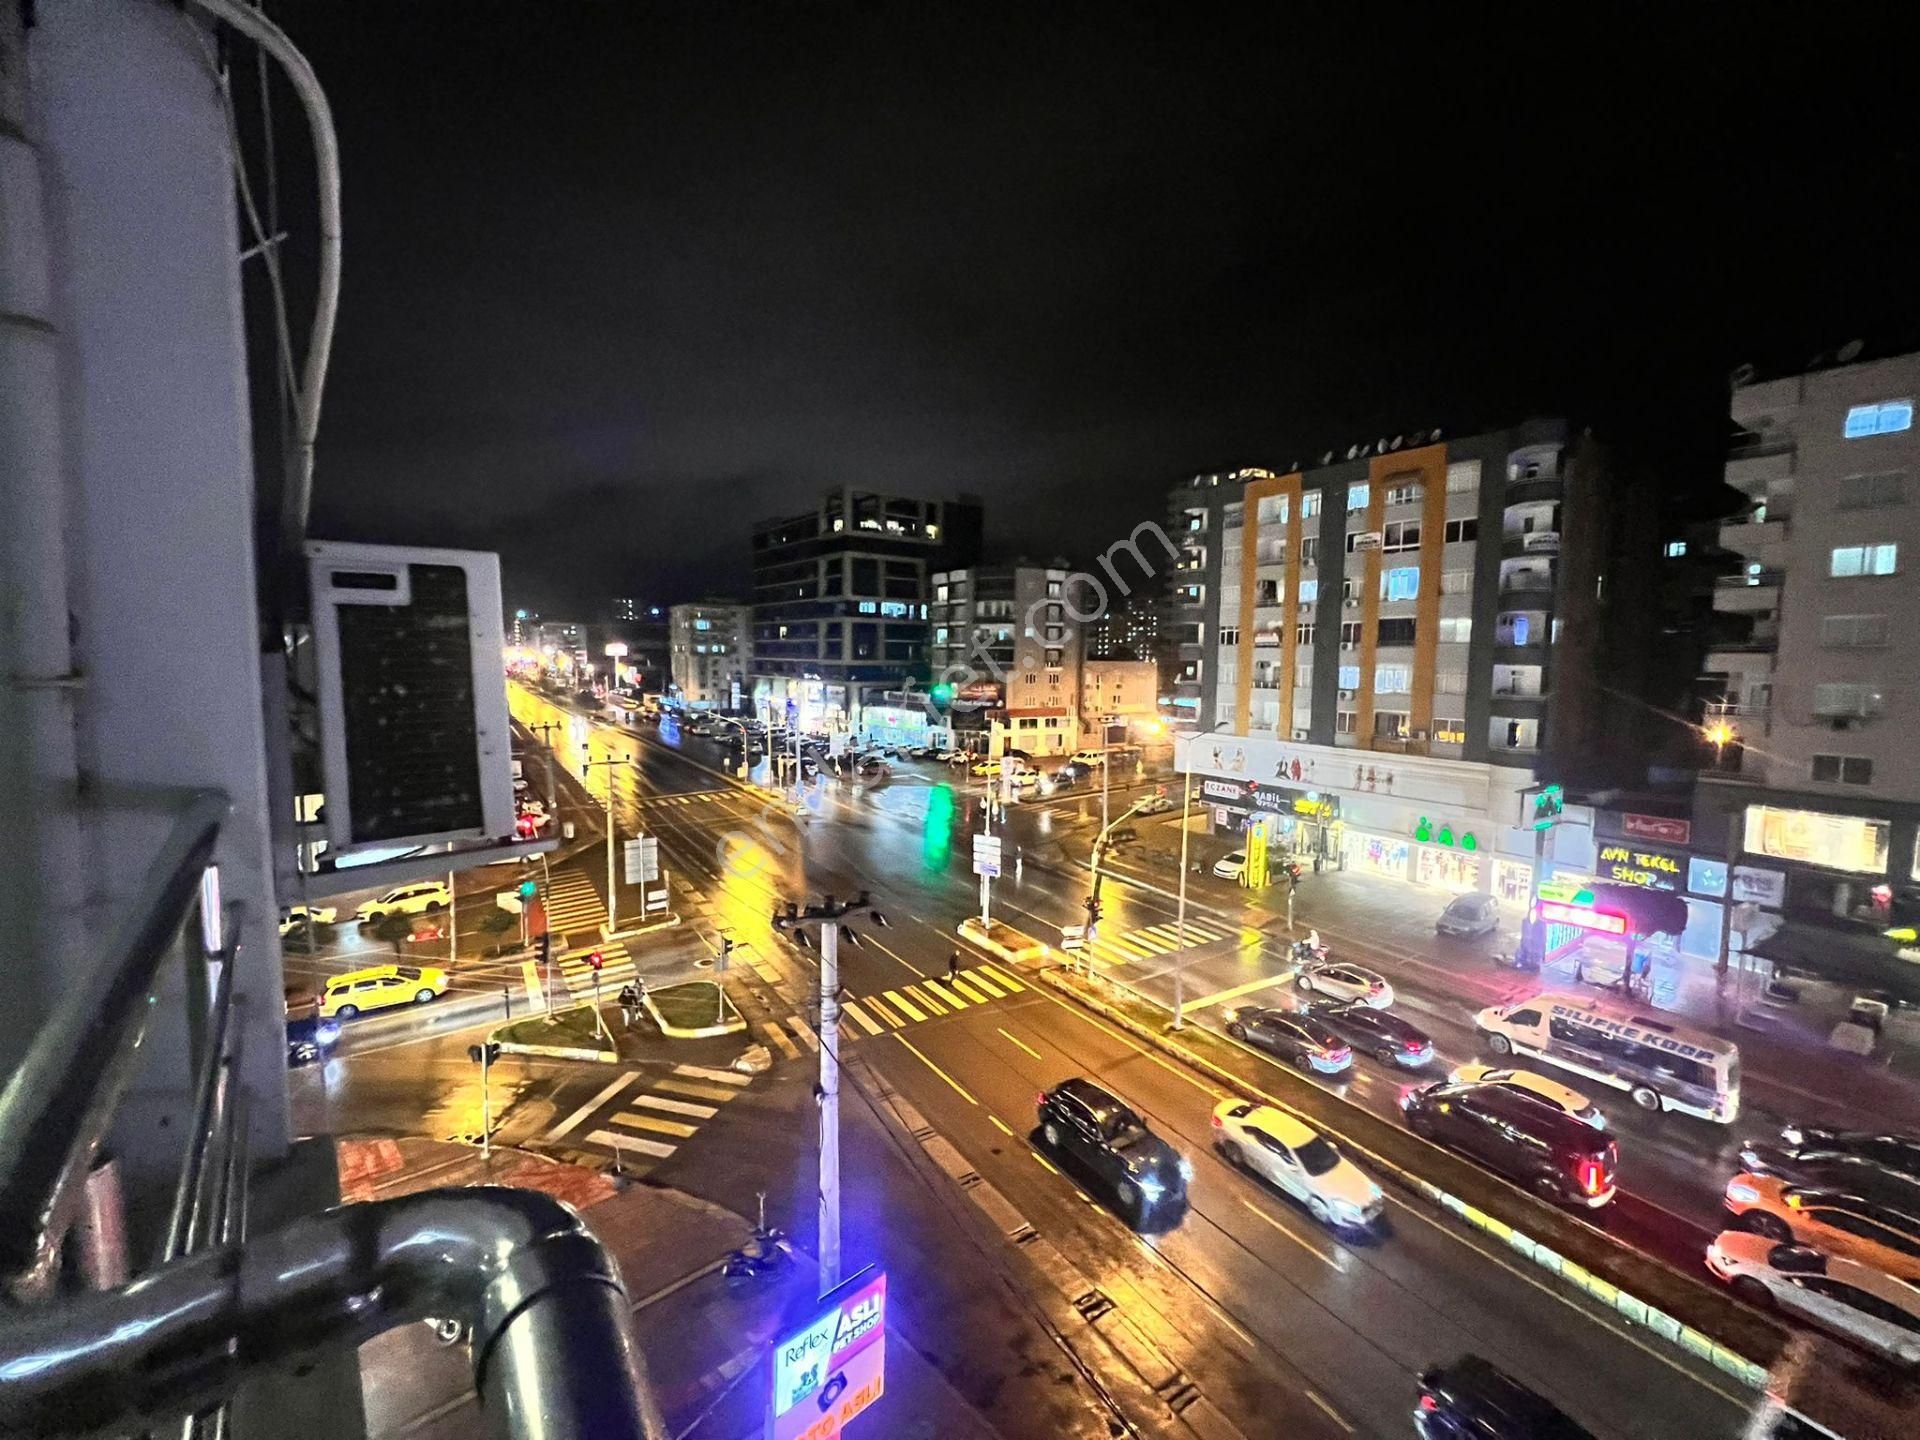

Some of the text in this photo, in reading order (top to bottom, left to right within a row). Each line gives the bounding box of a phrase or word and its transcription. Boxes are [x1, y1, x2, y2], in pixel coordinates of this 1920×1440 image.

[1206, 782, 1237, 795] ECZANE
[1633, 853, 1681, 873] TEKEL
[1612, 866, 1657, 887] SHOP
[785, 1328, 829, 1367] Reflex
